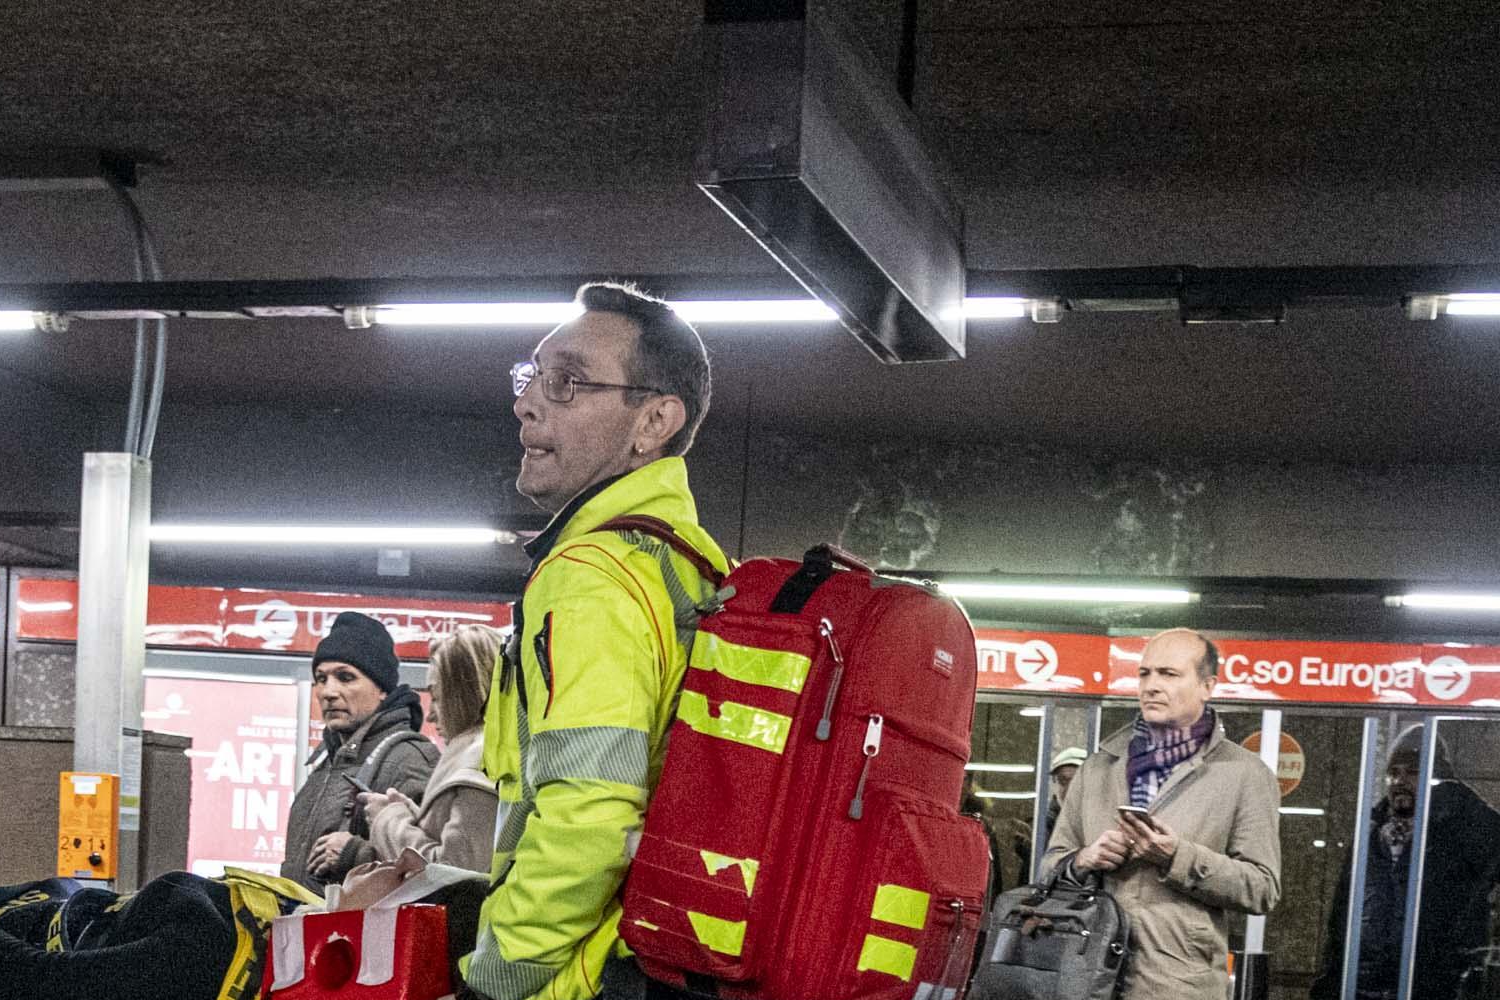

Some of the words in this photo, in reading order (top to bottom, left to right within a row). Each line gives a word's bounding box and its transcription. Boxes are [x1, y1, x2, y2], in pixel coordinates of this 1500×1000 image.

[1224, 654, 1294, 685] C.so
[1300, 656, 1415, 696] Europa
[231, 788, 279, 831] IN
